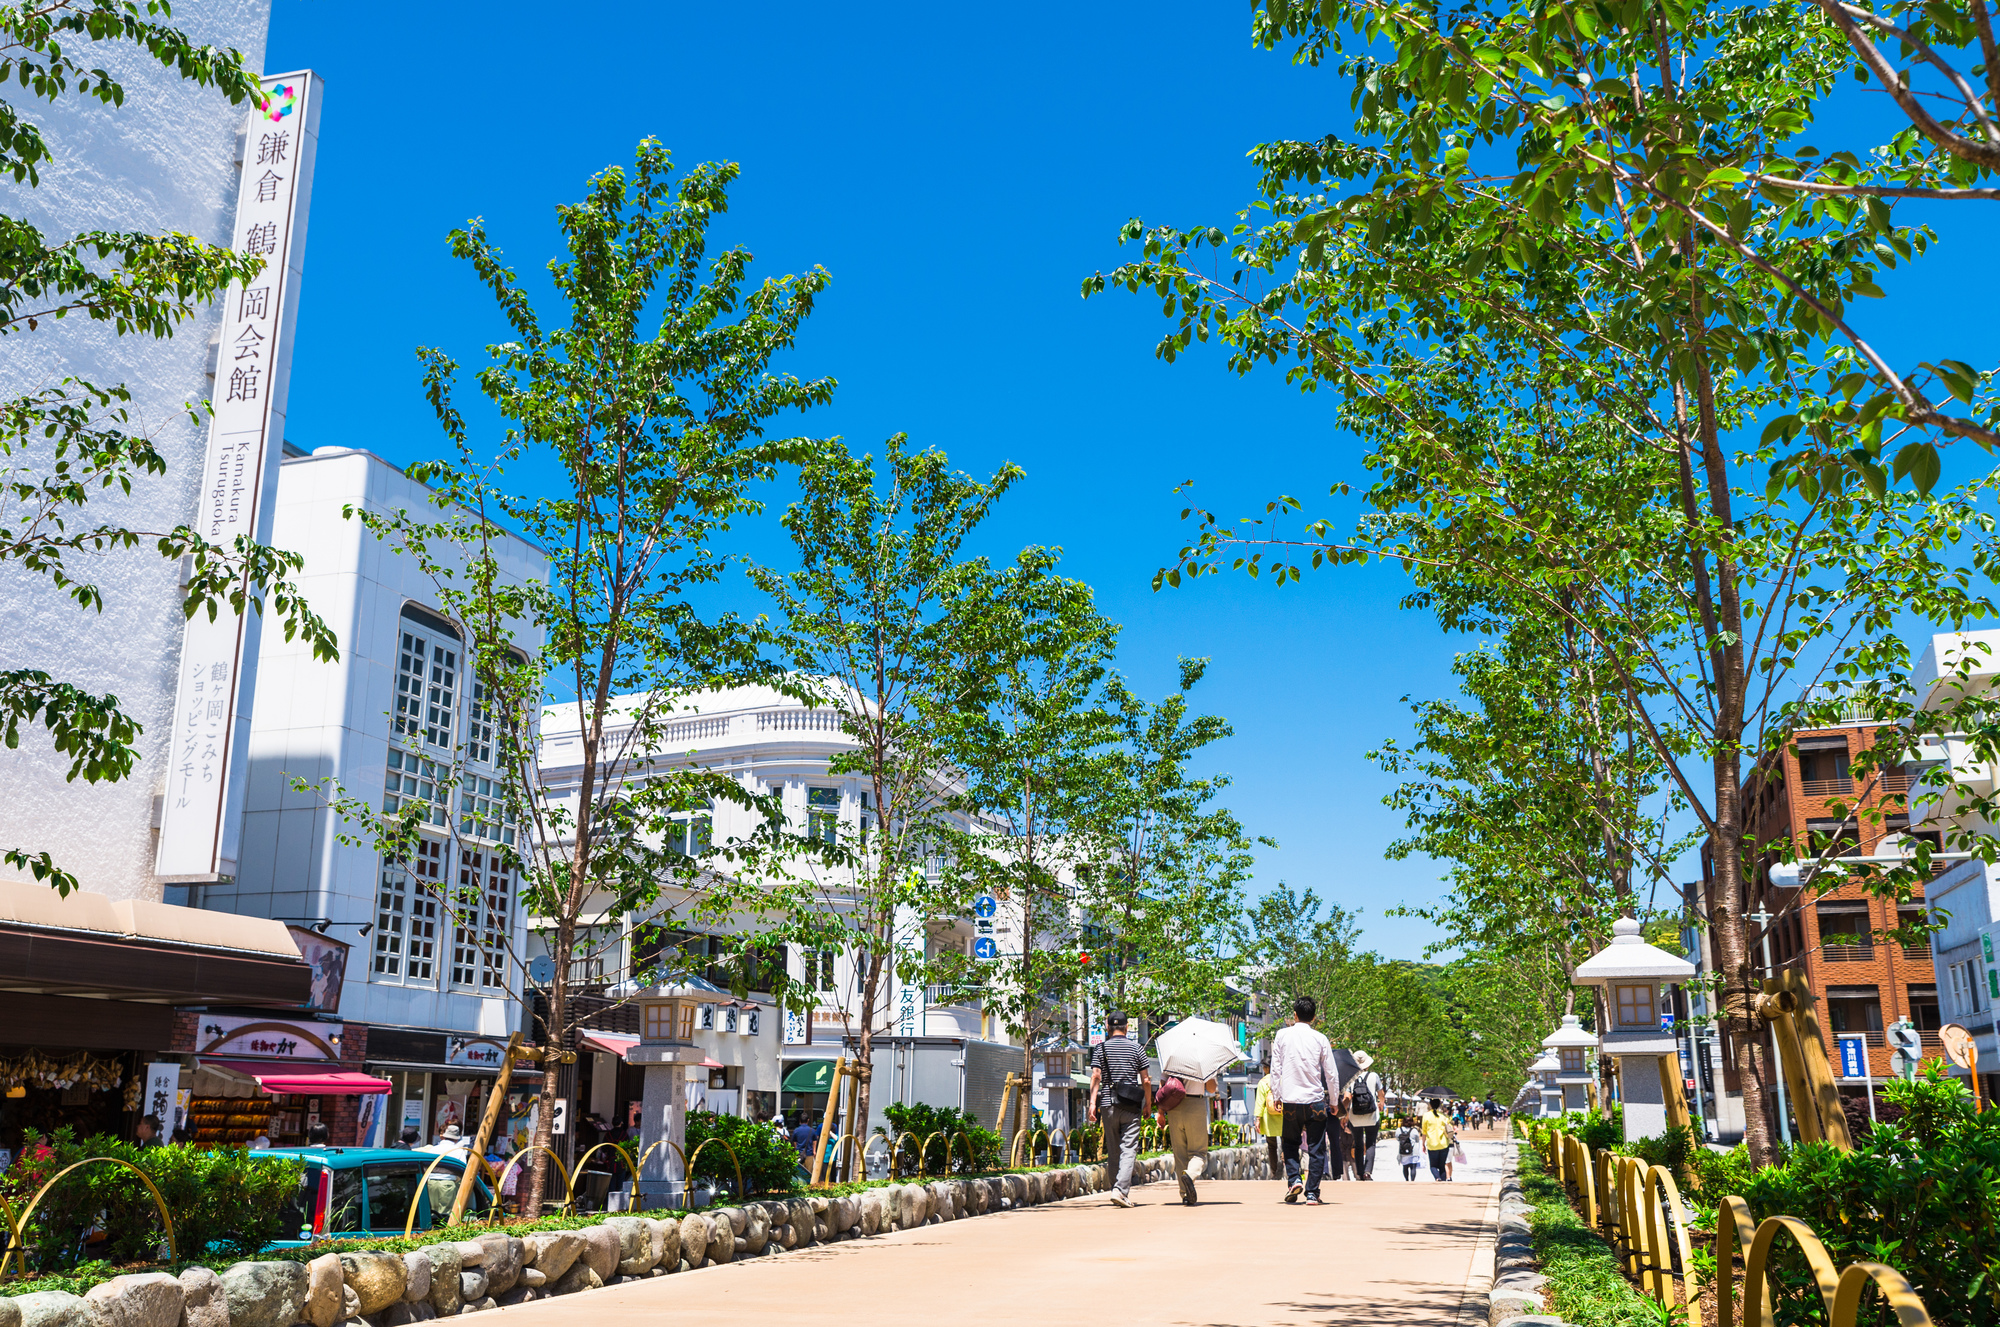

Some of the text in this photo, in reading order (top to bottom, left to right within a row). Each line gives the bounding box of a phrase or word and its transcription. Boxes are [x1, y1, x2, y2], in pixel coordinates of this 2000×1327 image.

[252, 130, 290, 204] 鎌倉
[211, 443, 235, 537] Tsurugaoka
[228, 442, 250, 524] Kamakura
[175, 663, 207, 809] ショッピングモール
